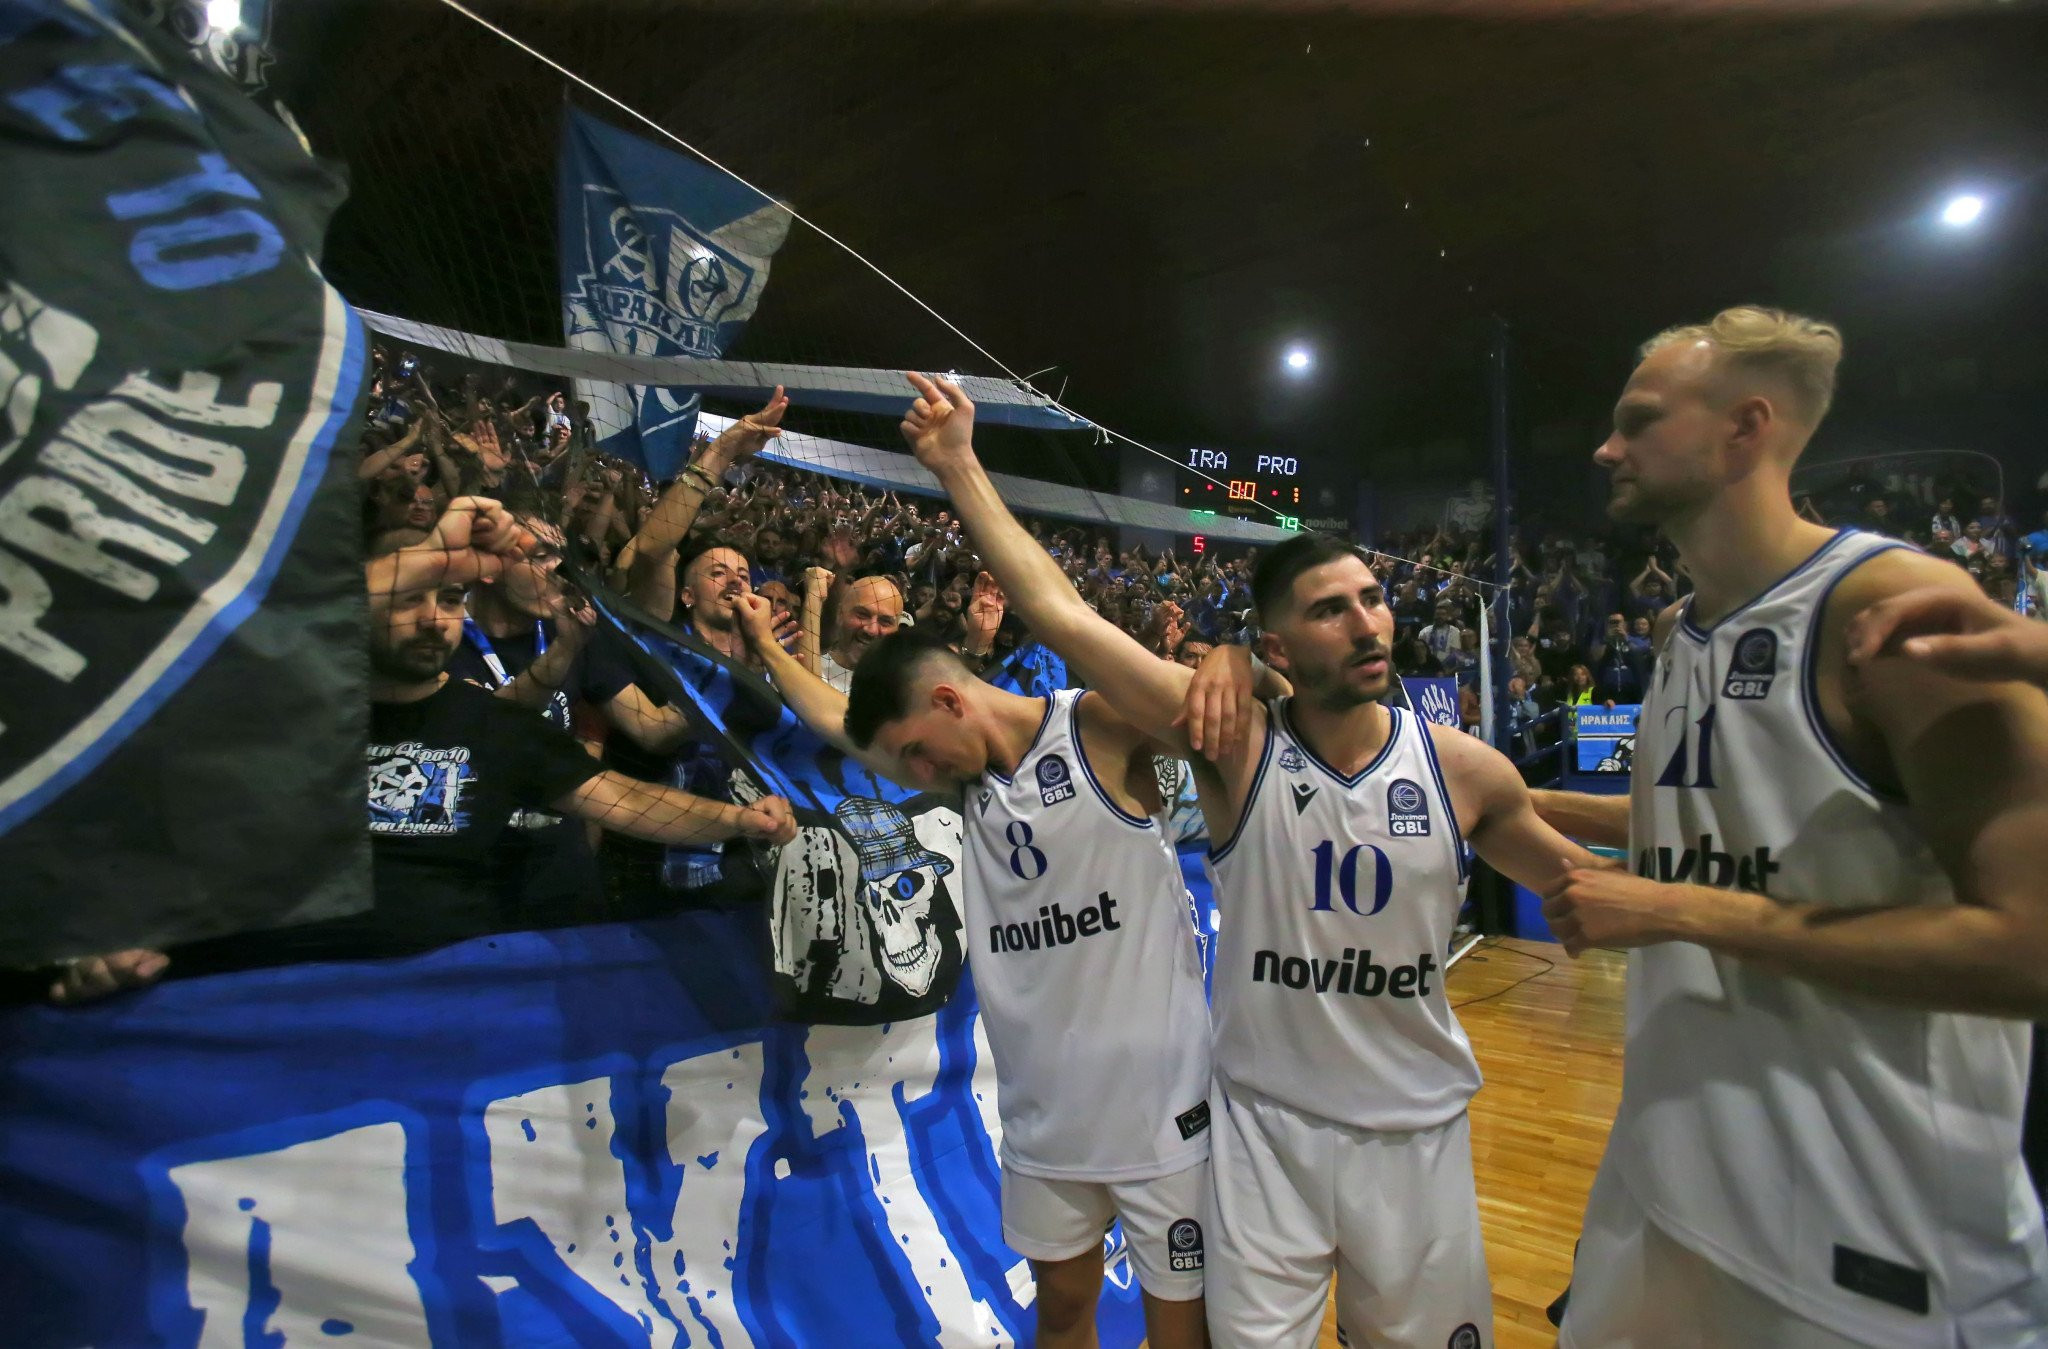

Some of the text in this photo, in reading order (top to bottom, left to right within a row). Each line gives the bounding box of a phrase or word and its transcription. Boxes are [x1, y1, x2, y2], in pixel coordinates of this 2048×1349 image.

[1188, 448, 1228, 470] IRA
[1256, 454, 1298, 476] PRO
[0, 368, 284, 684] PRIDE
[1275, 515, 1299, 532] 79
[1193, 535, 1206, 554] 5
[1727, 681, 1765, 697] GBL
[1580, 714, 1631, 726] ΗΡΑΚΛΗΣ
[1044, 787, 1073, 804] GBL
[1390, 813, 1428, 822] Stoiximan
[1392, 821, 1428, 835] GBL
[1005, 820, 1048, 881] 8
[1308, 840, 1394, 917] 10
[989, 891, 1121, 954] novibet
[1252, 947, 1437, 999] novibet
[1172, 1255, 1203, 1270] GBL
